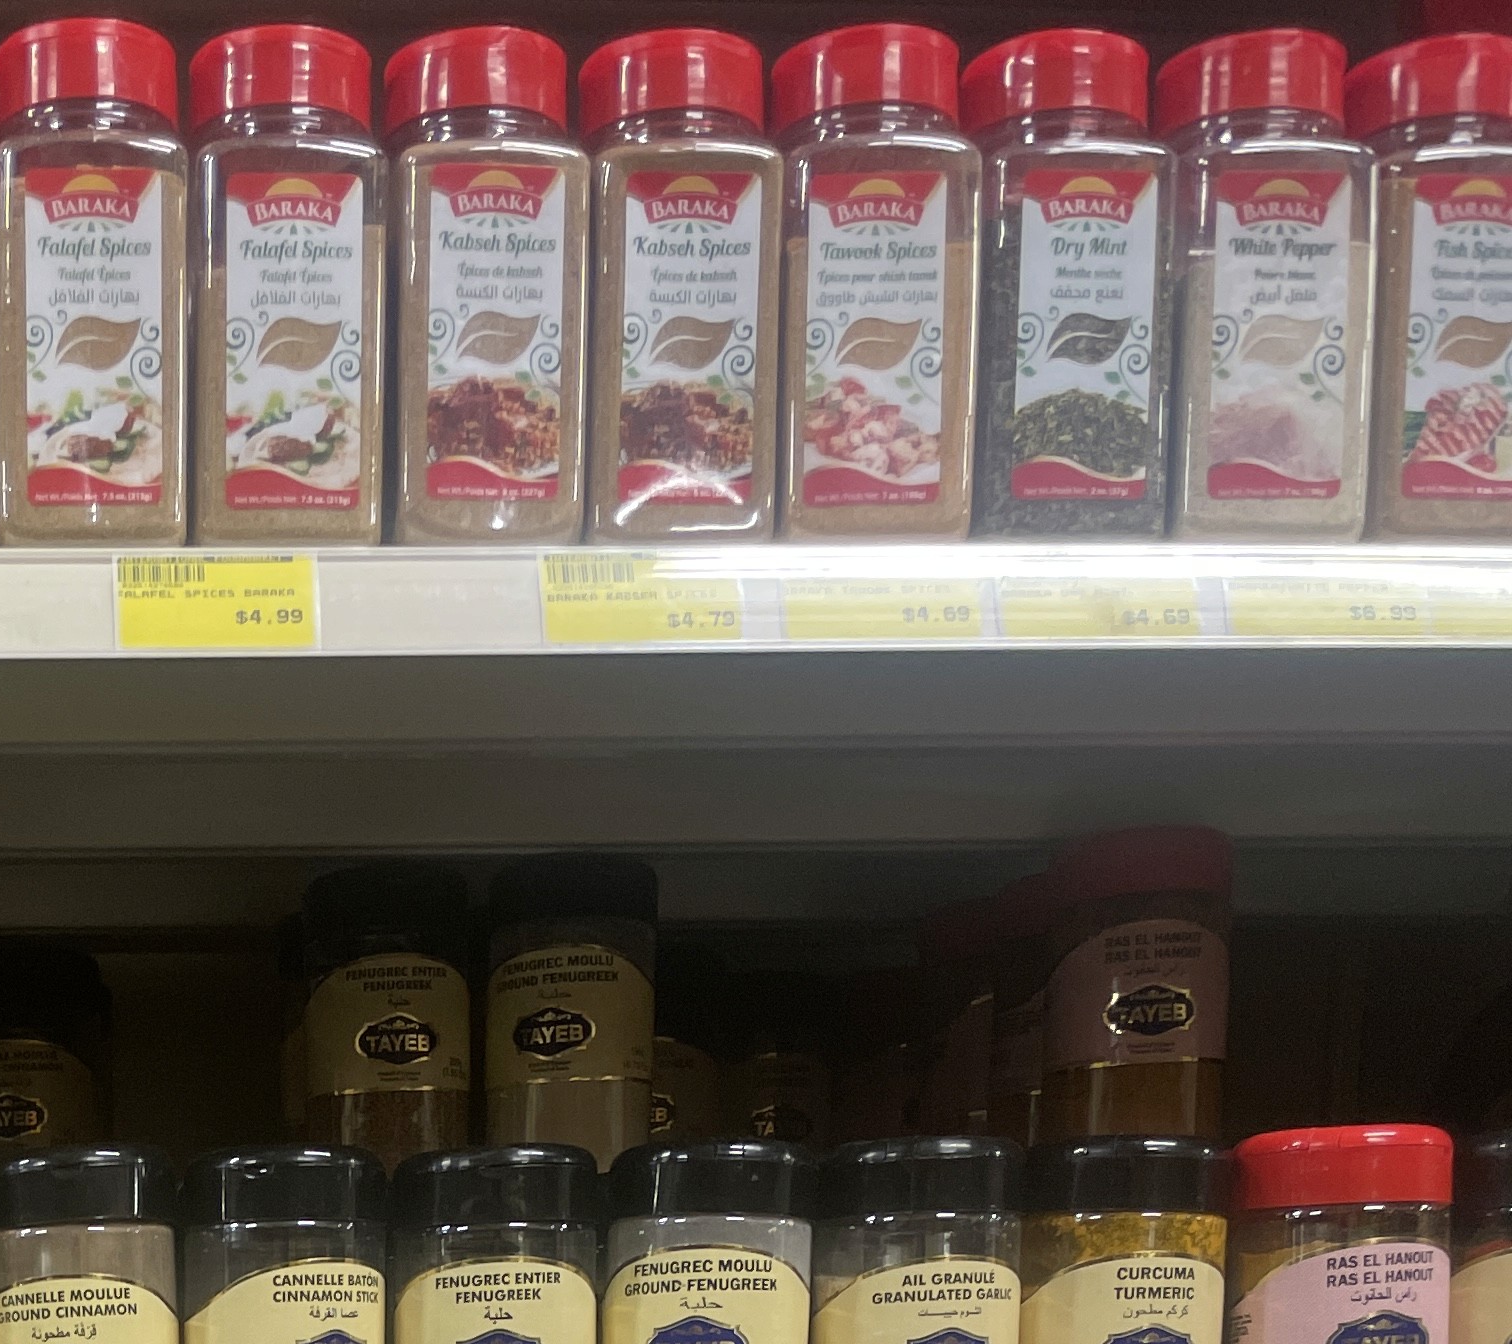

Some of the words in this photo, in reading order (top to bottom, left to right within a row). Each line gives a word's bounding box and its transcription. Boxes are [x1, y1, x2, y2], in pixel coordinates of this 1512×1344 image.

[254, 200, 333, 223] BARAKA
[651, 198, 730, 221] BARAKA
[38, 237, 94, 261] Falafel
[99, 239, 151, 261] Spices
[633, 237, 695, 256] Kabseh
[699, 239, 751, 261] Spices
[820, 242, 883, 259] Tawook
[887, 243, 937, 264] Spices
[1051, 238, 1087, 259] Dry
[1091, 238, 1127, 255] Mint
[1229, 239, 1278, 257] White
[1282, 239, 1336, 262] Pepper
[235, 608, 304, 625] $4.99
[667, 610, 735, 629] $4.79
[1349, 604, 1417, 621] $6.99
[543, 969, 619, 985] FENUGREEK
[365, 1033, 430, 1053] TAYEB
[1326, 1255, 1357, 1271] RAS
[1363, 1254, 1381, 1268] EL
[1384, 1250, 1434, 1267] HANOUT
[434, 1274, 512, 1290] FENUGREC
[514, 1272, 561, 1286] ENTIER
[1115, 1266, 1196, 1281] CURCUMA
[455, 1288, 542, 1304] FENUGREEK
[1113, 1285, 1196, 1301] TURMERIC
